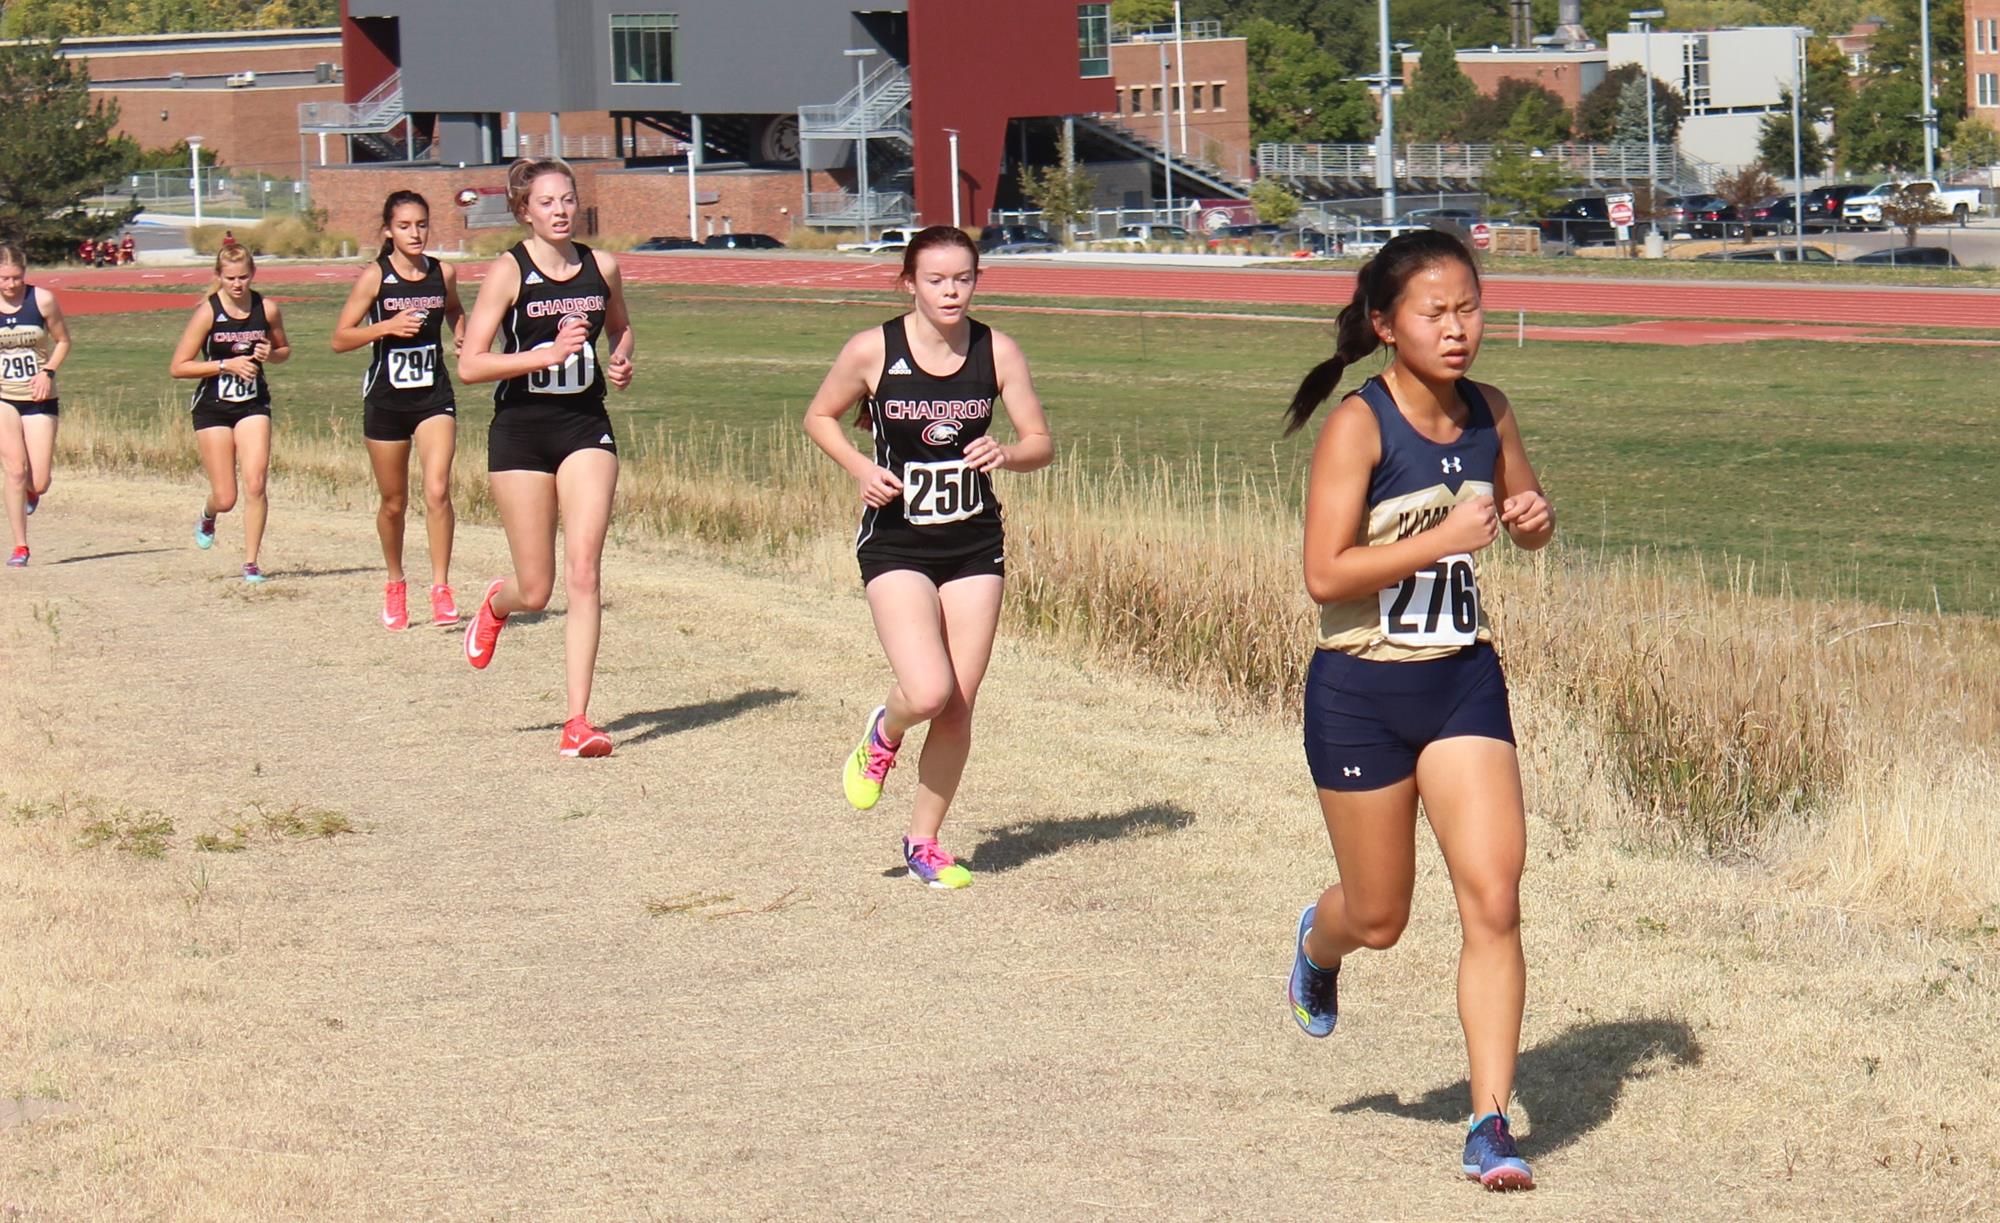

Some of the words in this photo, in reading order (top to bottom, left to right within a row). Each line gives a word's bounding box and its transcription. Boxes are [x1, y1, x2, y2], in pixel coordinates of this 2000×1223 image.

[527, 296, 606, 318] CHADRON
[2, 355, 36, 379] 296
[393, 349, 435, 382] 294
[886, 399, 991, 419] CHADRON
[910, 468, 977, 516] 250
[1388, 560, 1477, 634] 276
